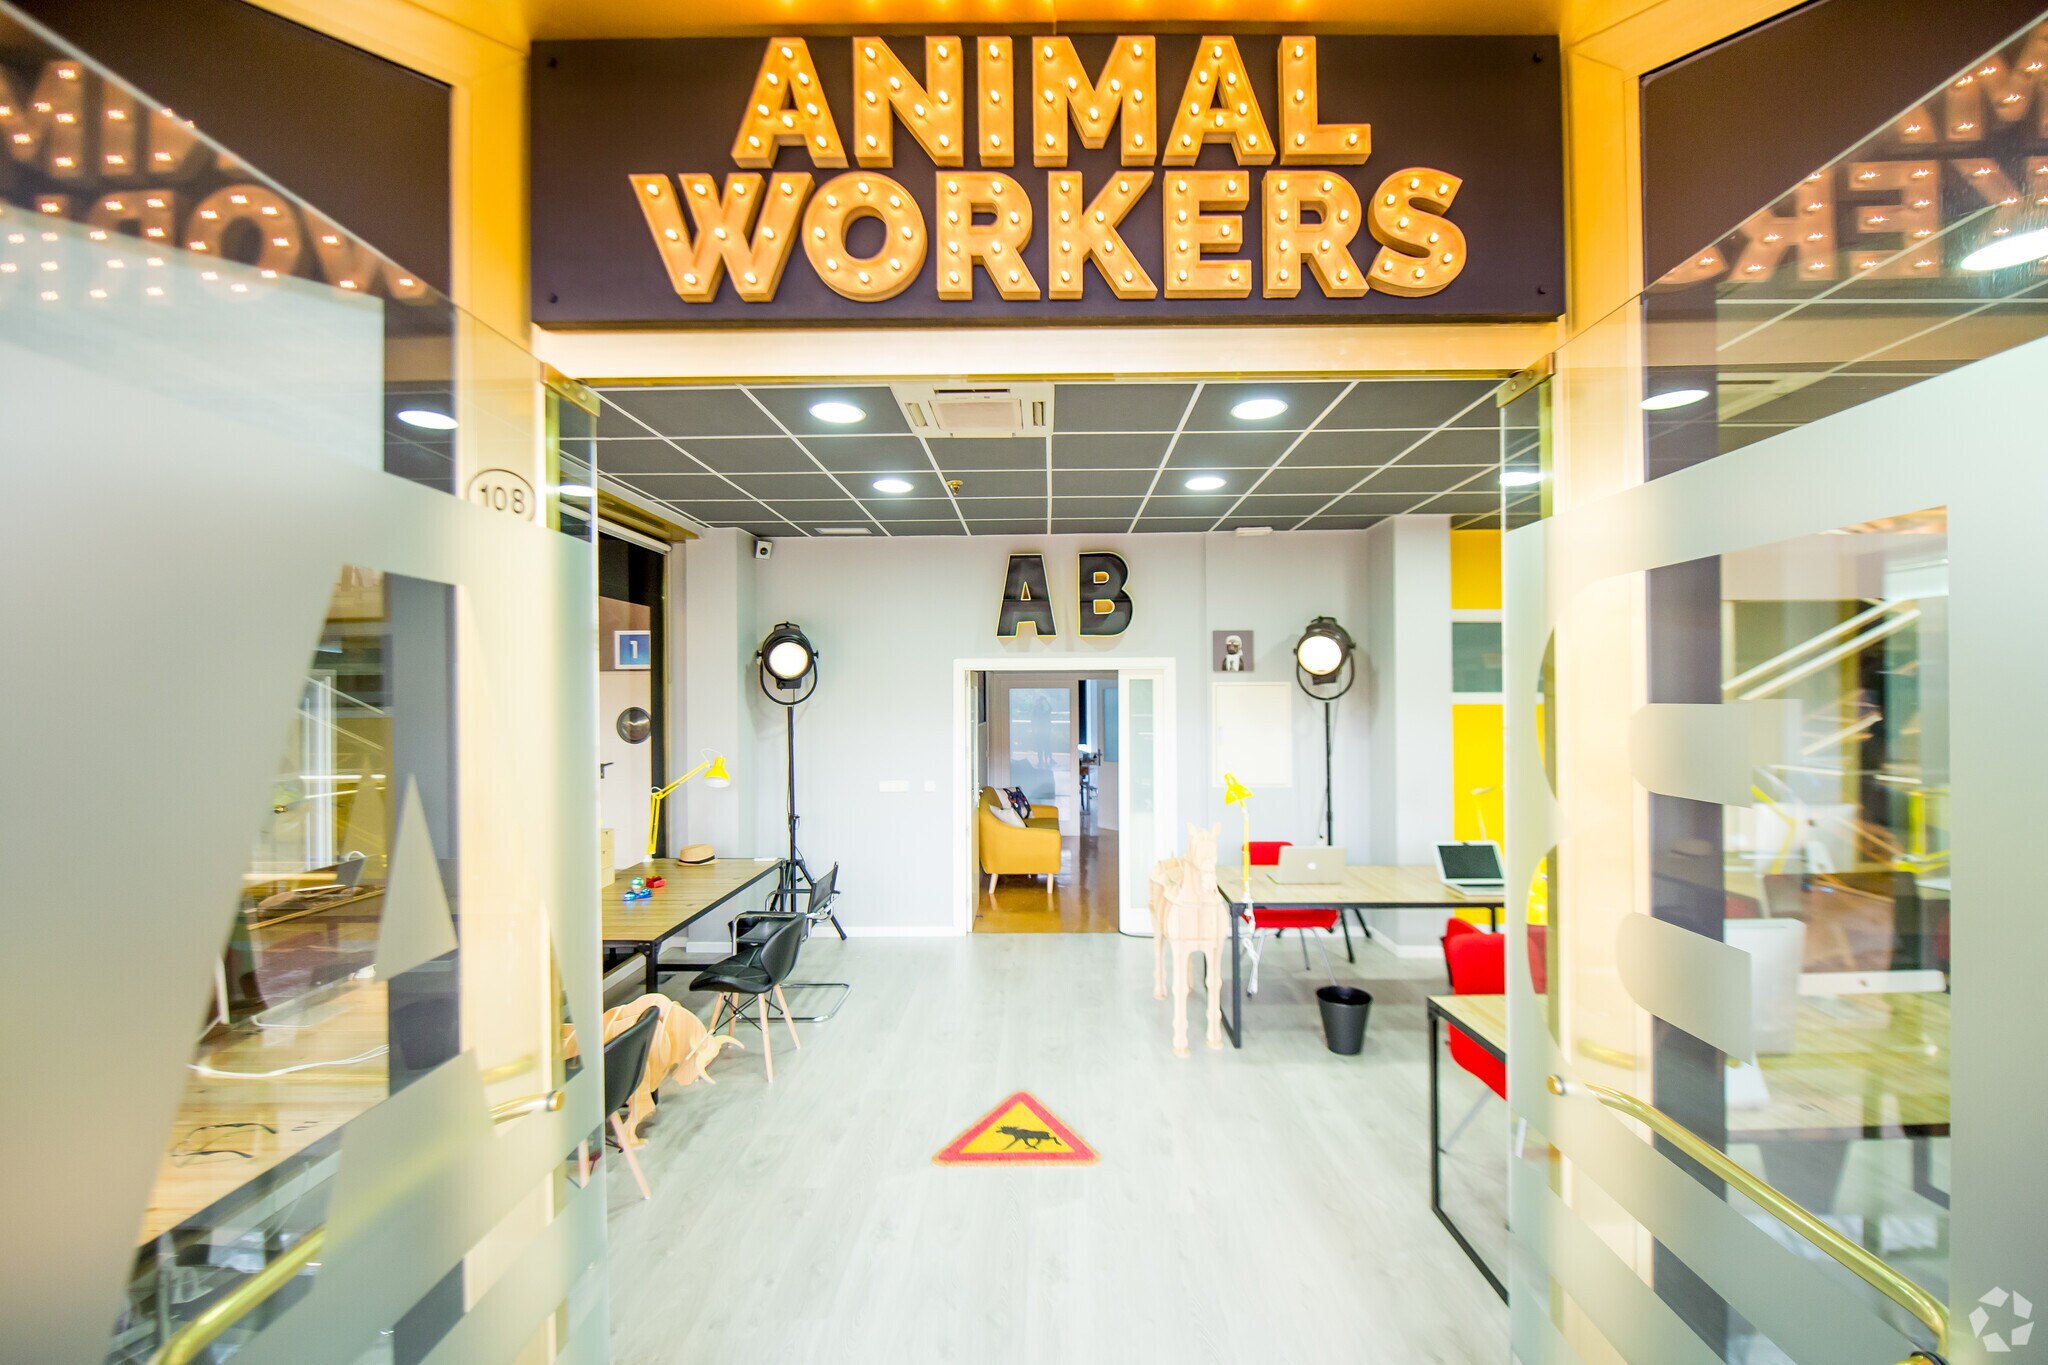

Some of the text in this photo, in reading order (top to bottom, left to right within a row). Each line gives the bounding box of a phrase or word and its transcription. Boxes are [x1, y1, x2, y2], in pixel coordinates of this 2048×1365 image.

[731, 35, 1371, 167] ANIMAL
[628, 168, 1467, 302] WORKERS
[480, 484, 525, 514] 108
[629, 640, 639, 659] 1
